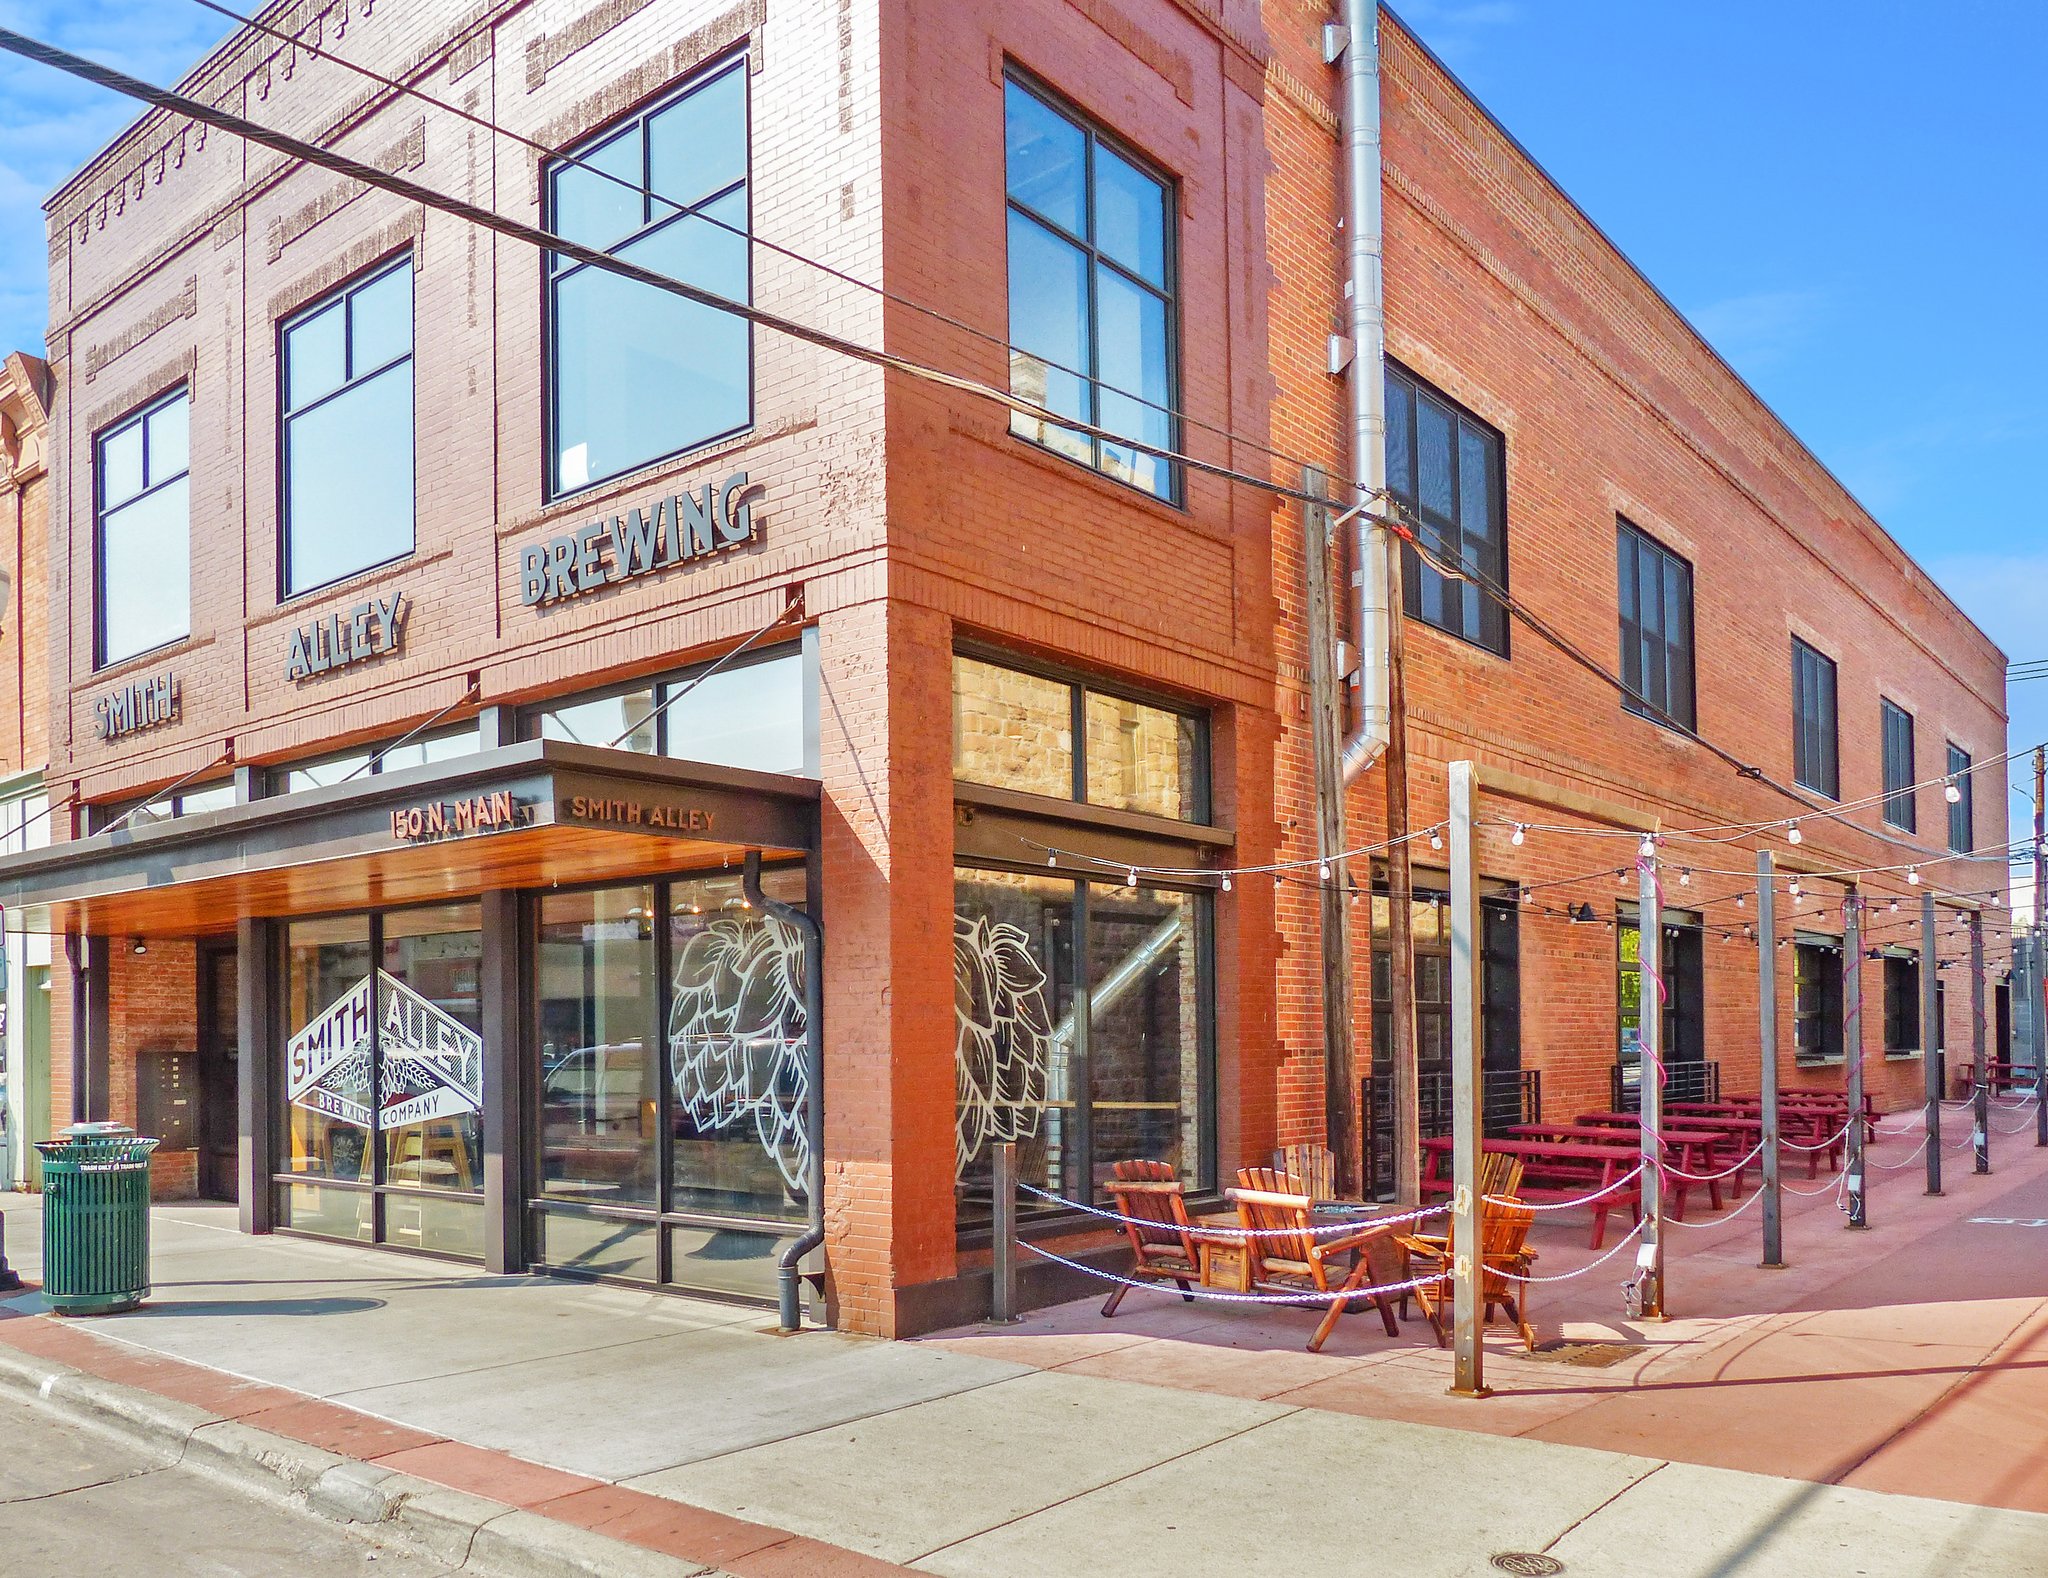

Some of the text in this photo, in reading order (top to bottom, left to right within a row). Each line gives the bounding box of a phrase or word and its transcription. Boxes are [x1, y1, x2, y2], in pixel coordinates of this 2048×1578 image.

[94, 471, 751, 740] SMITH ALLEY BREWING
[390, 790, 513, 840] 150 N. MAIN
[572, 795, 716, 832] SMITH ALLEY
[293, 987, 474, 1085] SMITH ALLEY
[382, 1094, 440, 1126] COMPANY
